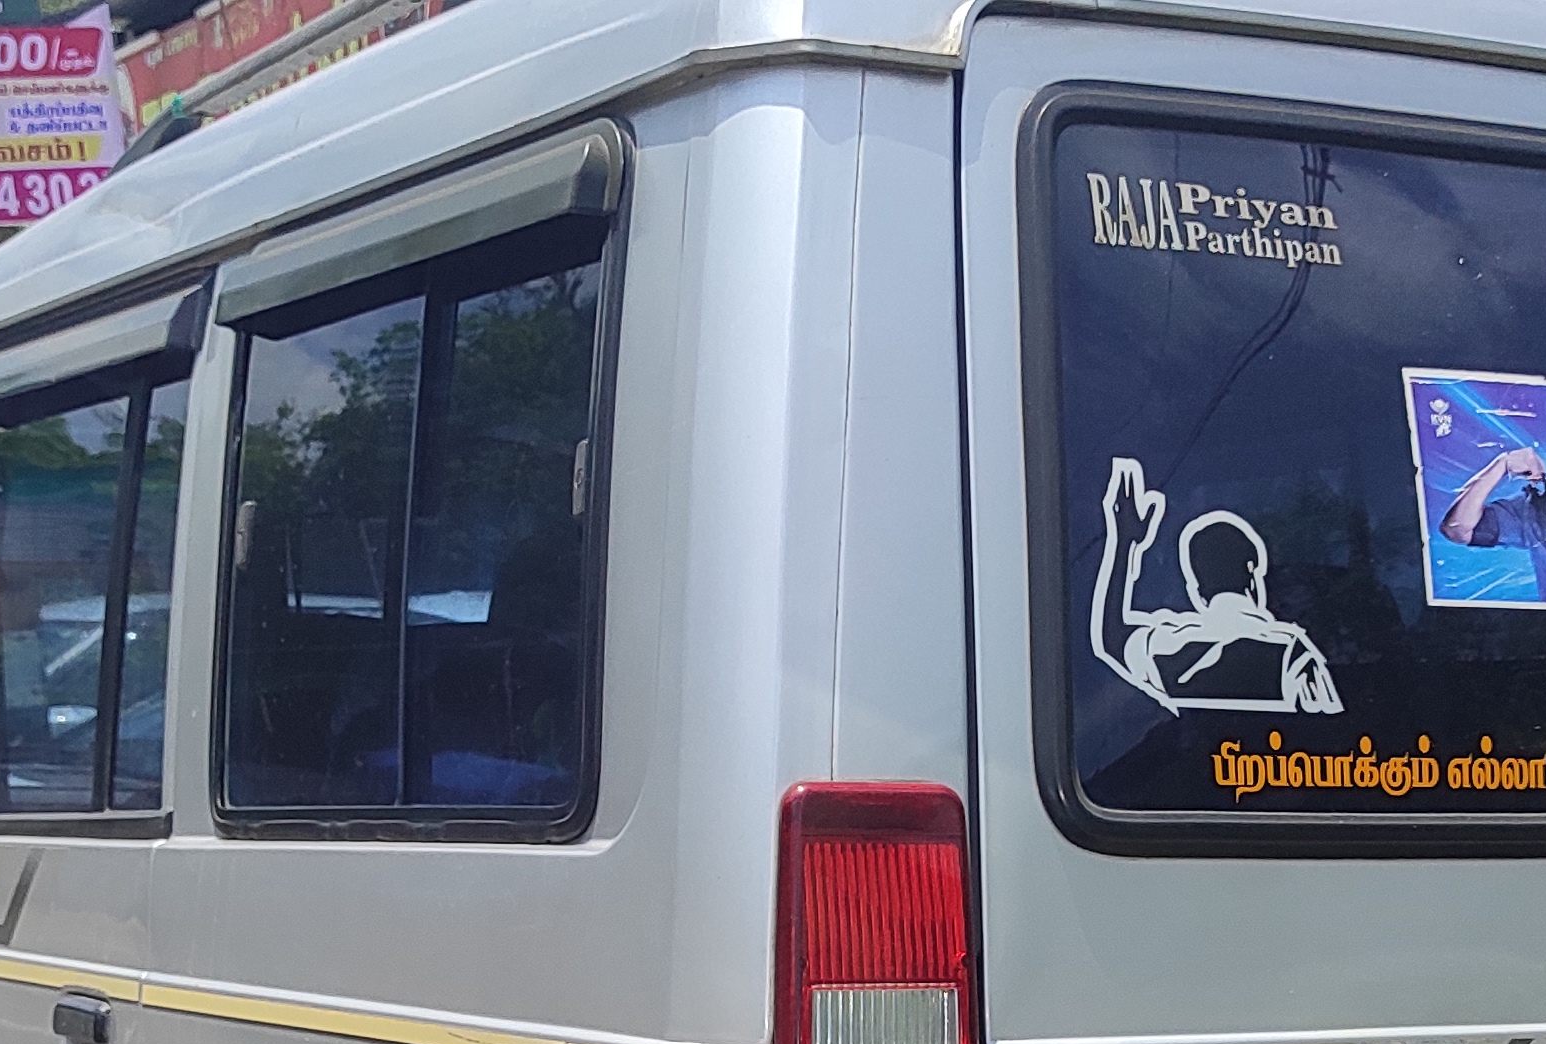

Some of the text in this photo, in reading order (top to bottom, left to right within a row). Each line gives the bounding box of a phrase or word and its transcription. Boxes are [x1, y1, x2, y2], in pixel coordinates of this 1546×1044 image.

[1086, 172, 1339, 251] RAJA Priyan
[1183, 220, 1343, 269] Parthipan
[1210, 730, 1440, 803] பிறப்பொக்கும்
[1447, 735, 1546, 790] எல்லா
